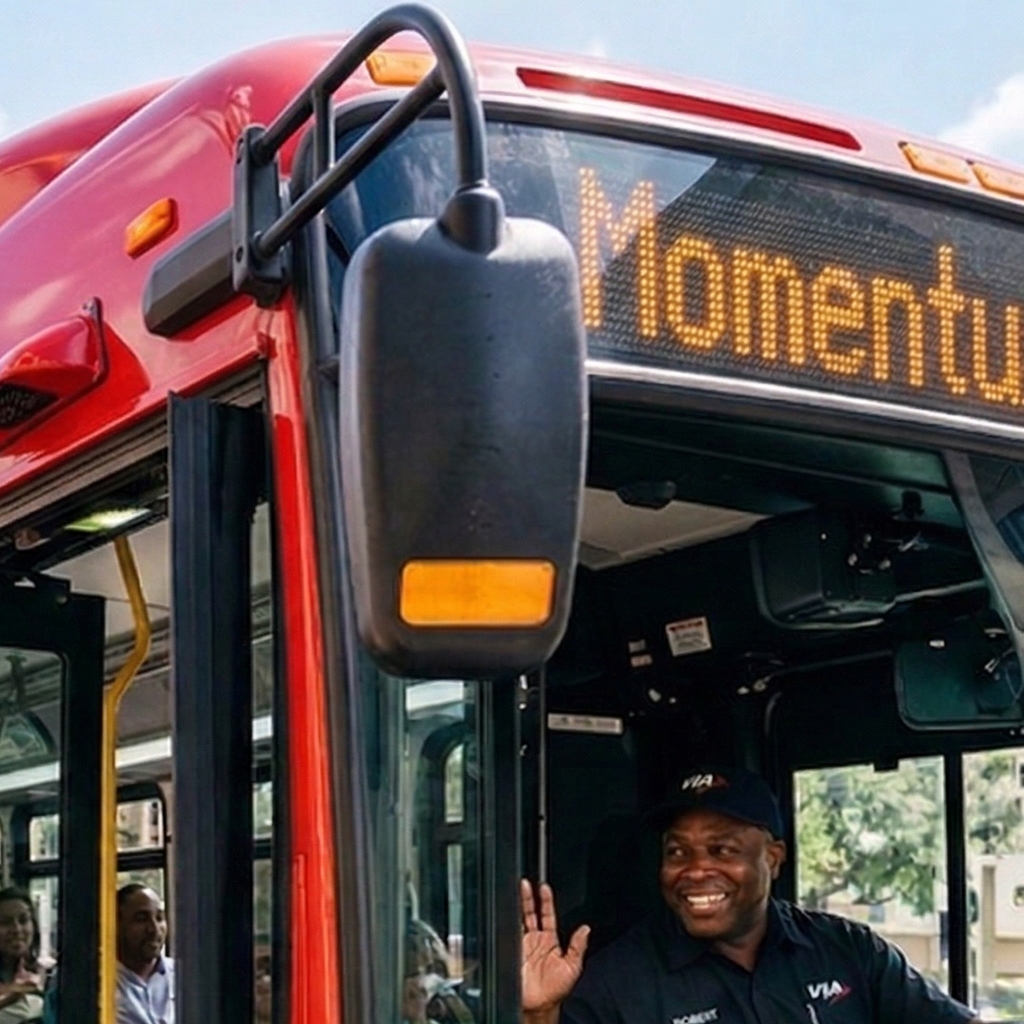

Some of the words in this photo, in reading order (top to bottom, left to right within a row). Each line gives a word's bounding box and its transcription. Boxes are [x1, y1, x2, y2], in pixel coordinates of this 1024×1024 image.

[579, 166, 1024, 406] Momentu
[682, 774, 714, 790] VIA
[808, 980, 843, 1000] VIA
